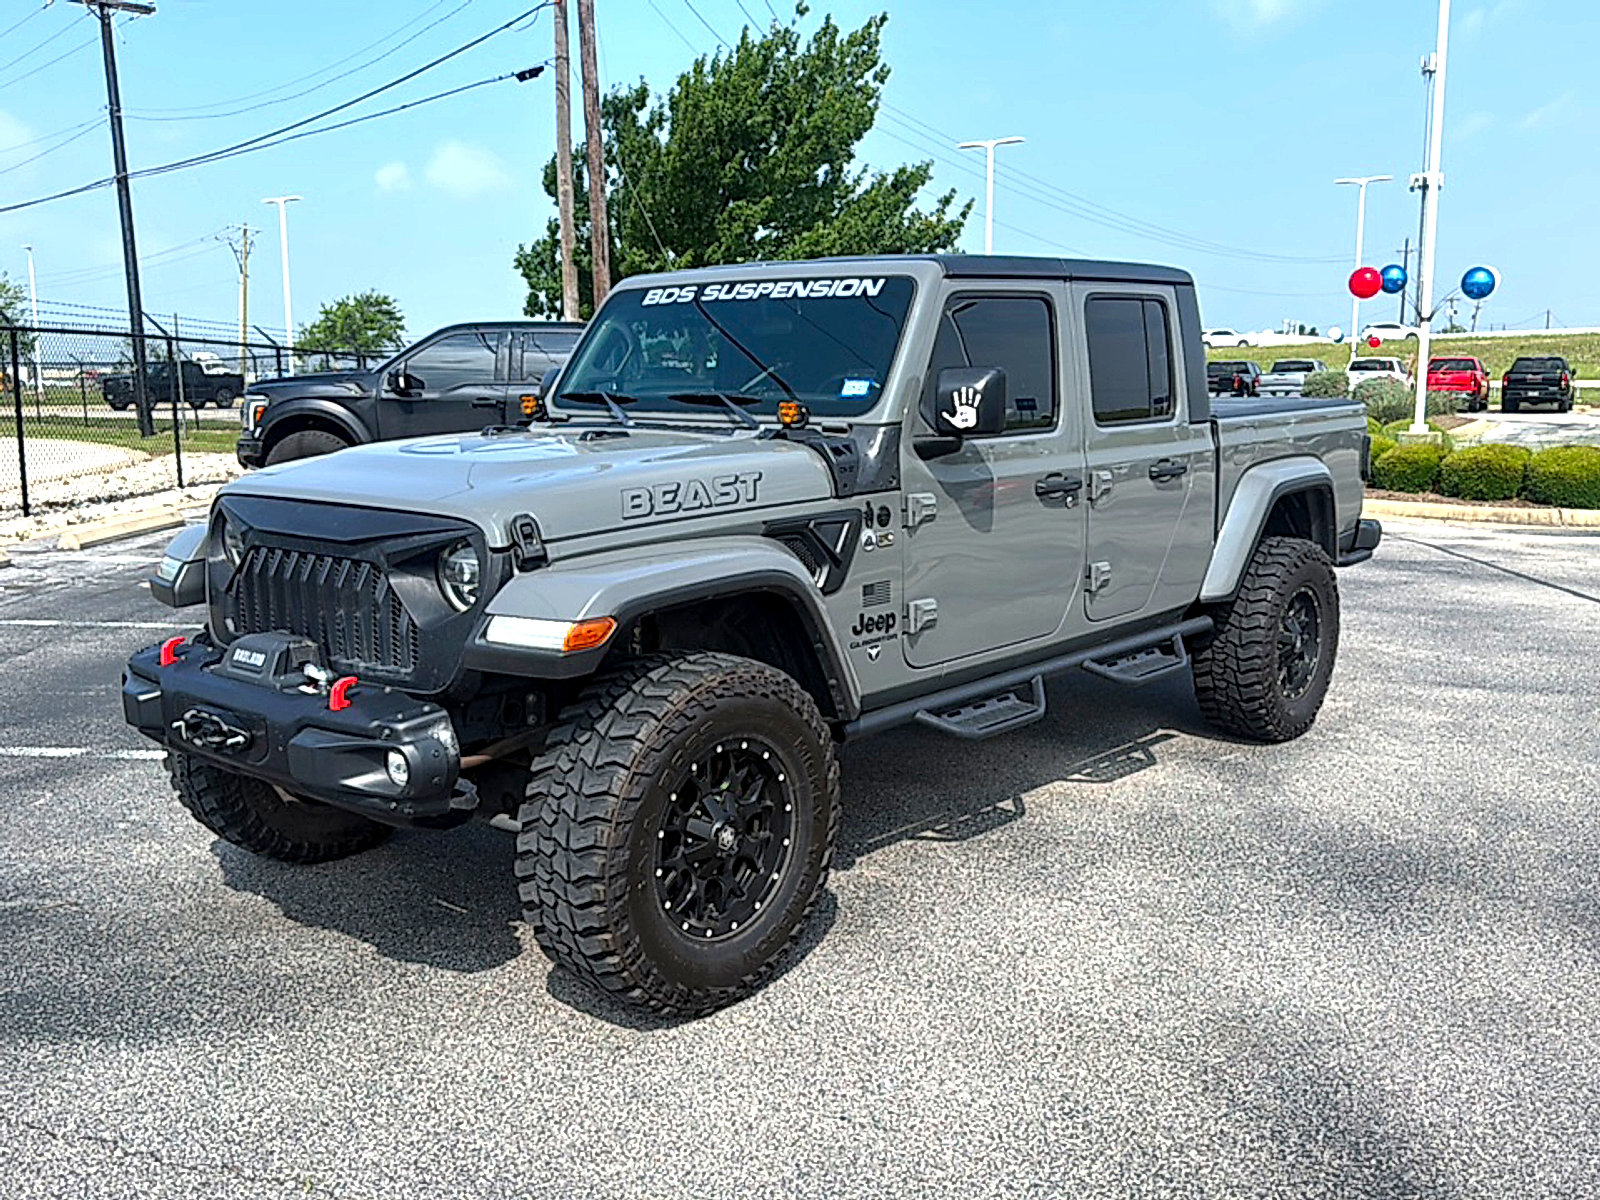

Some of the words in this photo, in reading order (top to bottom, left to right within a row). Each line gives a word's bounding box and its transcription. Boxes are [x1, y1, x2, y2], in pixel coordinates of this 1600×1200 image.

[641, 286, 698, 306] BDS
[700, 278, 886, 301] SUSPENSION
[621, 472, 762, 520] BEAST
[852, 612, 896, 636] Jeep
